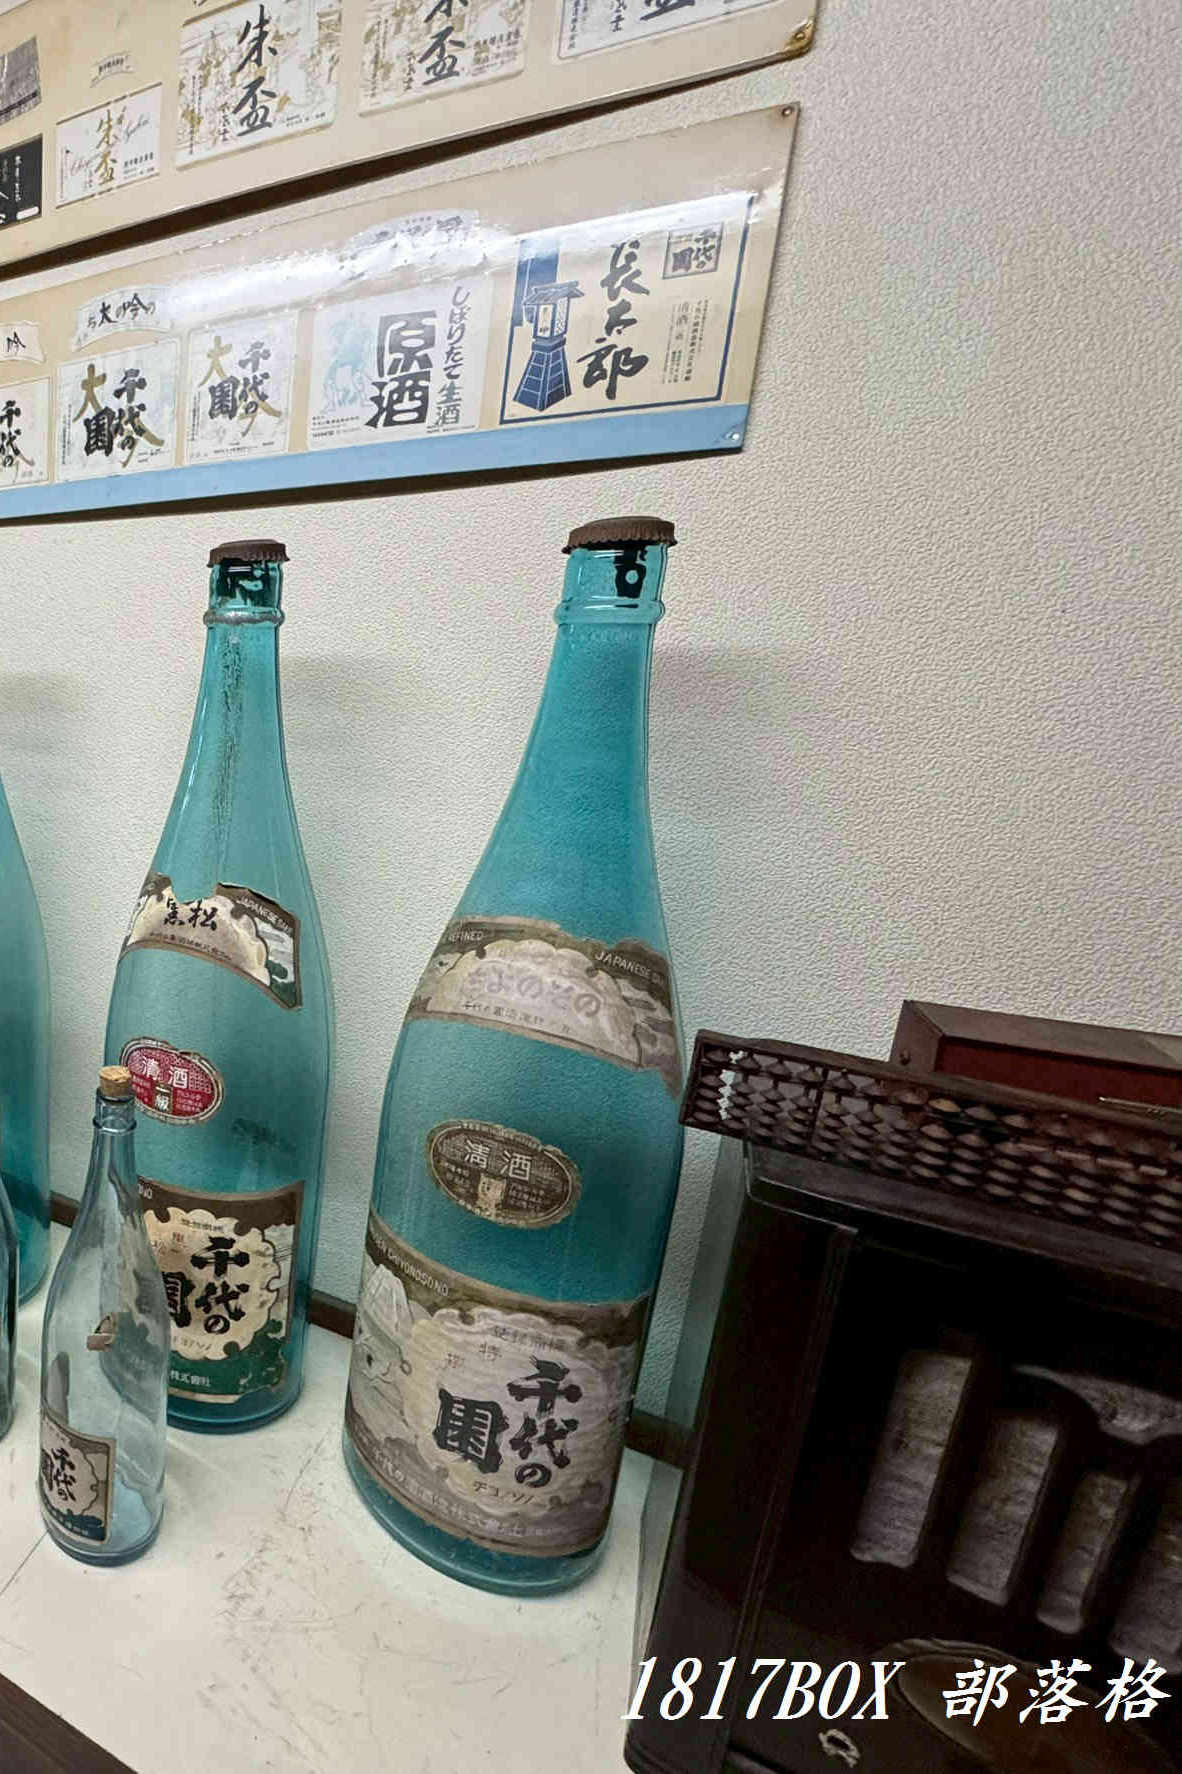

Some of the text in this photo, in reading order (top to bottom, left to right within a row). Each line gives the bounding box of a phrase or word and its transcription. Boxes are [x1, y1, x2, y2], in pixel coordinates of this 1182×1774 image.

[364, 310, 437, 429] 原酒
[433, 286, 471, 427] しぼりたて生酒
[464, 1138, 533, 1181] 清酒
[189, 1235, 251, 1335] 千代の
[506, 1355, 584, 1489] 千代の
